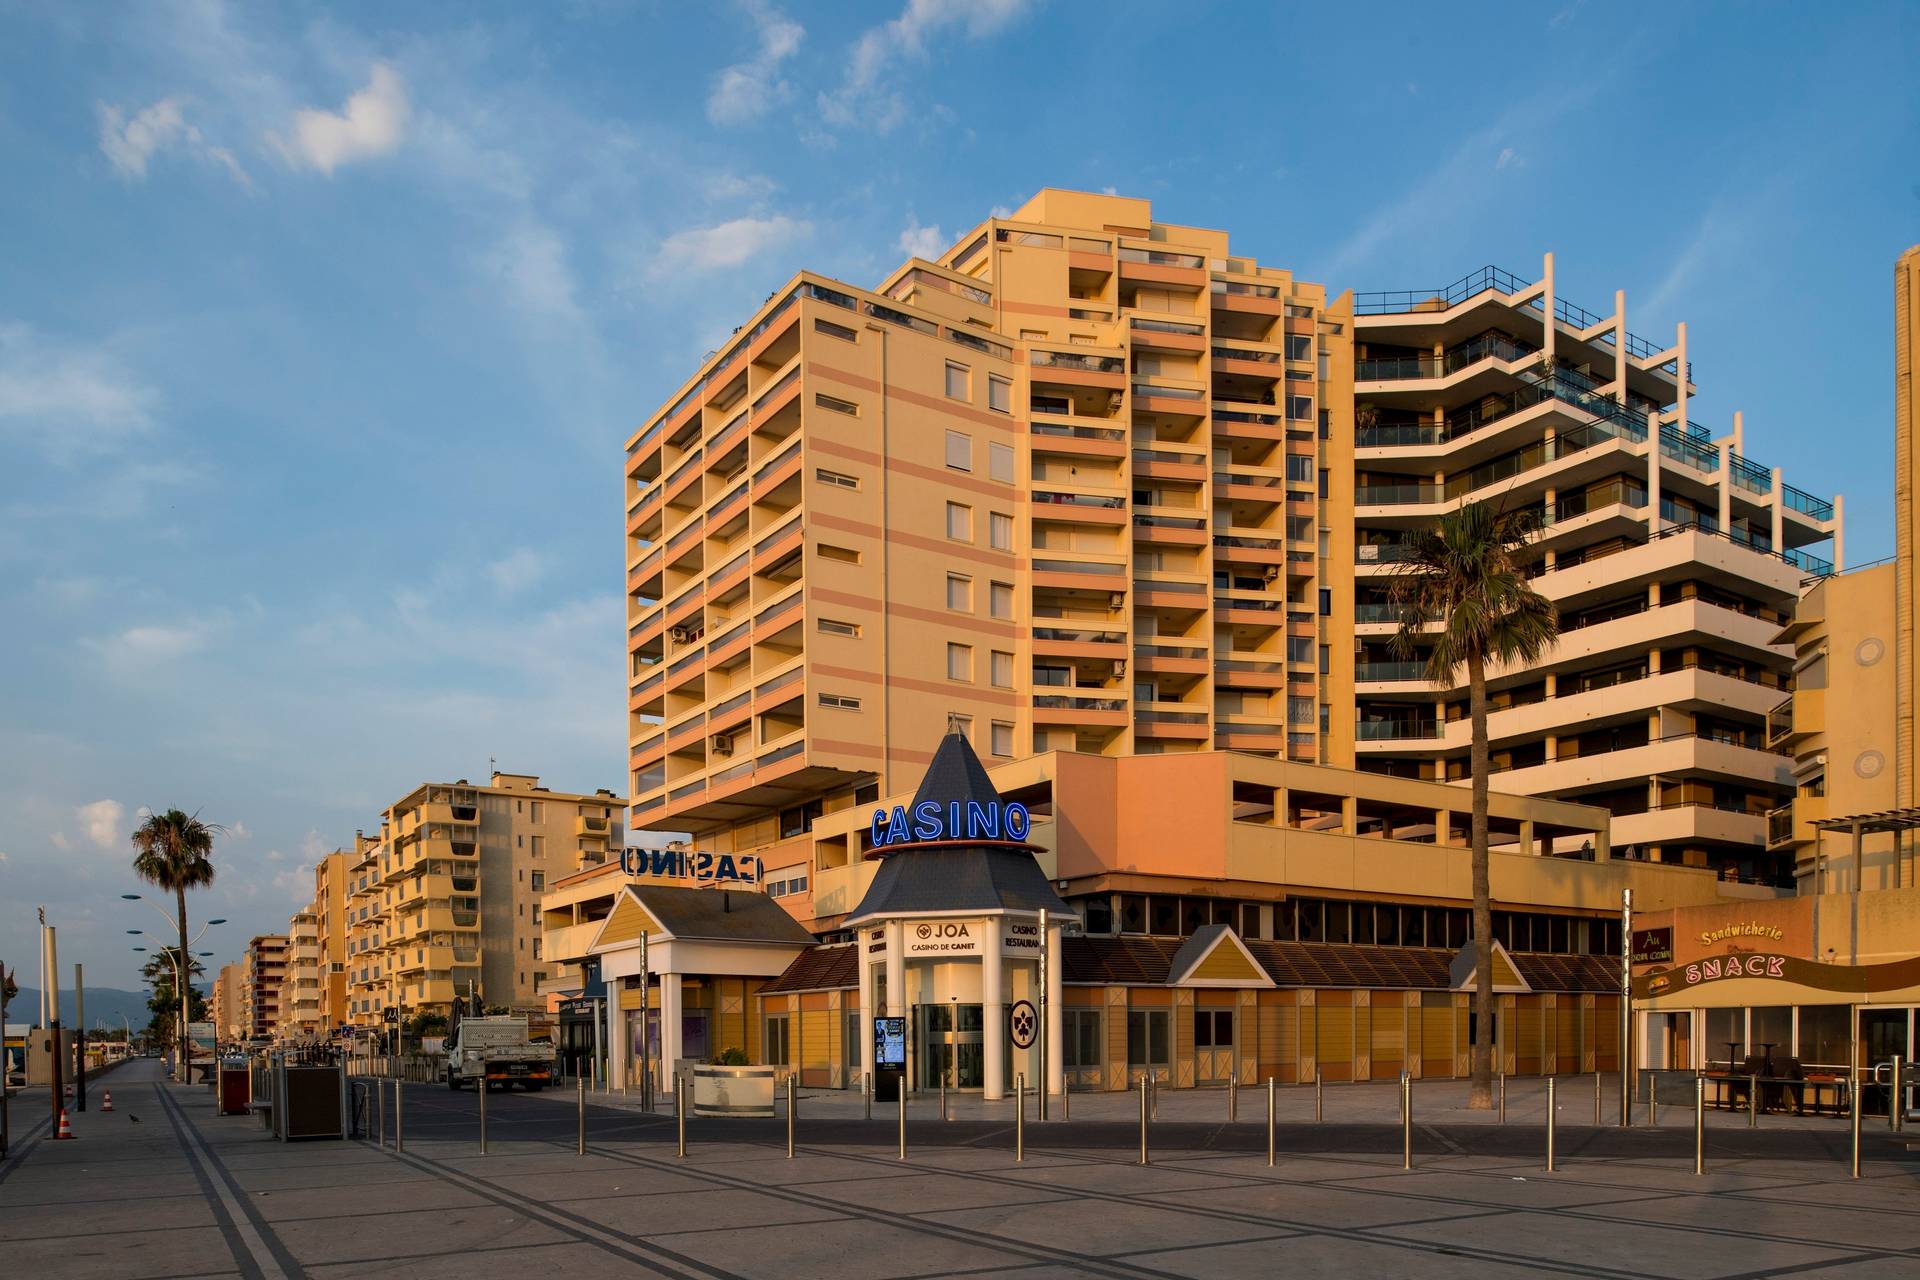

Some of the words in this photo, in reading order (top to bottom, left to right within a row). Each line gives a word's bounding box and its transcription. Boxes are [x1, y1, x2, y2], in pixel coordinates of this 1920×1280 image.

[871, 800, 1030, 848] CASINO
[935, 923, 969, 938] JOA
[1012, 925, 1038, 936] CASINO
[1700, 920, 1783, 945] Sandwicherie
[911, 943, 939, 951] CASINO
[1005, 937, 1040, 948] RESTAURAN
[1643, 931, 1660, 949] Au
[1685, 955, 1785, 983] SNACK
